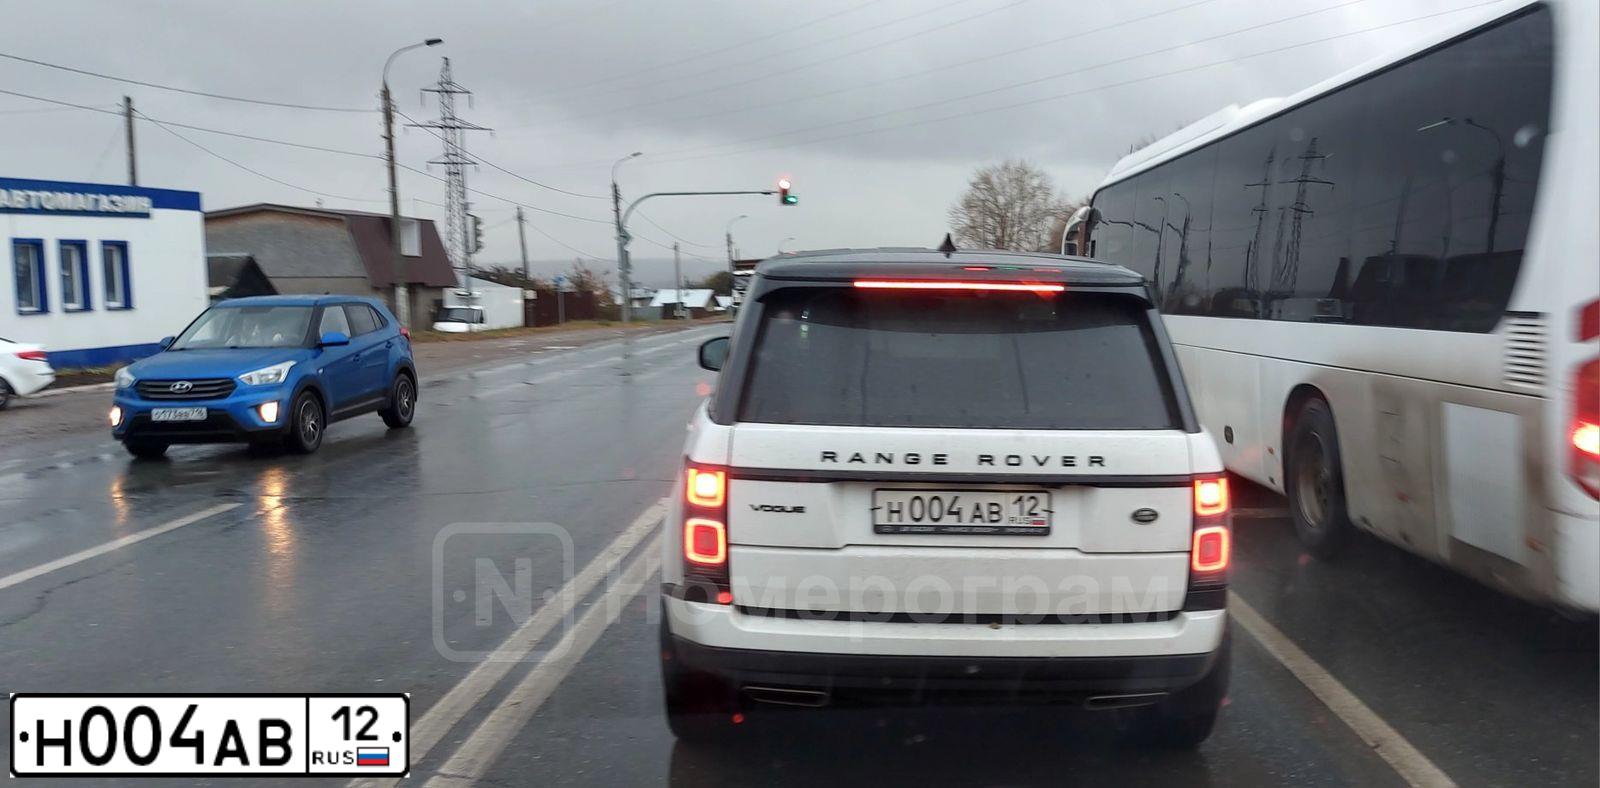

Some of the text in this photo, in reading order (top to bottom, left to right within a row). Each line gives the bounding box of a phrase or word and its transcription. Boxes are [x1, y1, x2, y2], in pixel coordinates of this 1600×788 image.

[820, 451, 1106, 467] RANGE ROVER
[749, 504, 806, 513] VOGUE
[1012, 496, 1039, 516] 12
[1009, 516, 1030, 524] RUS
